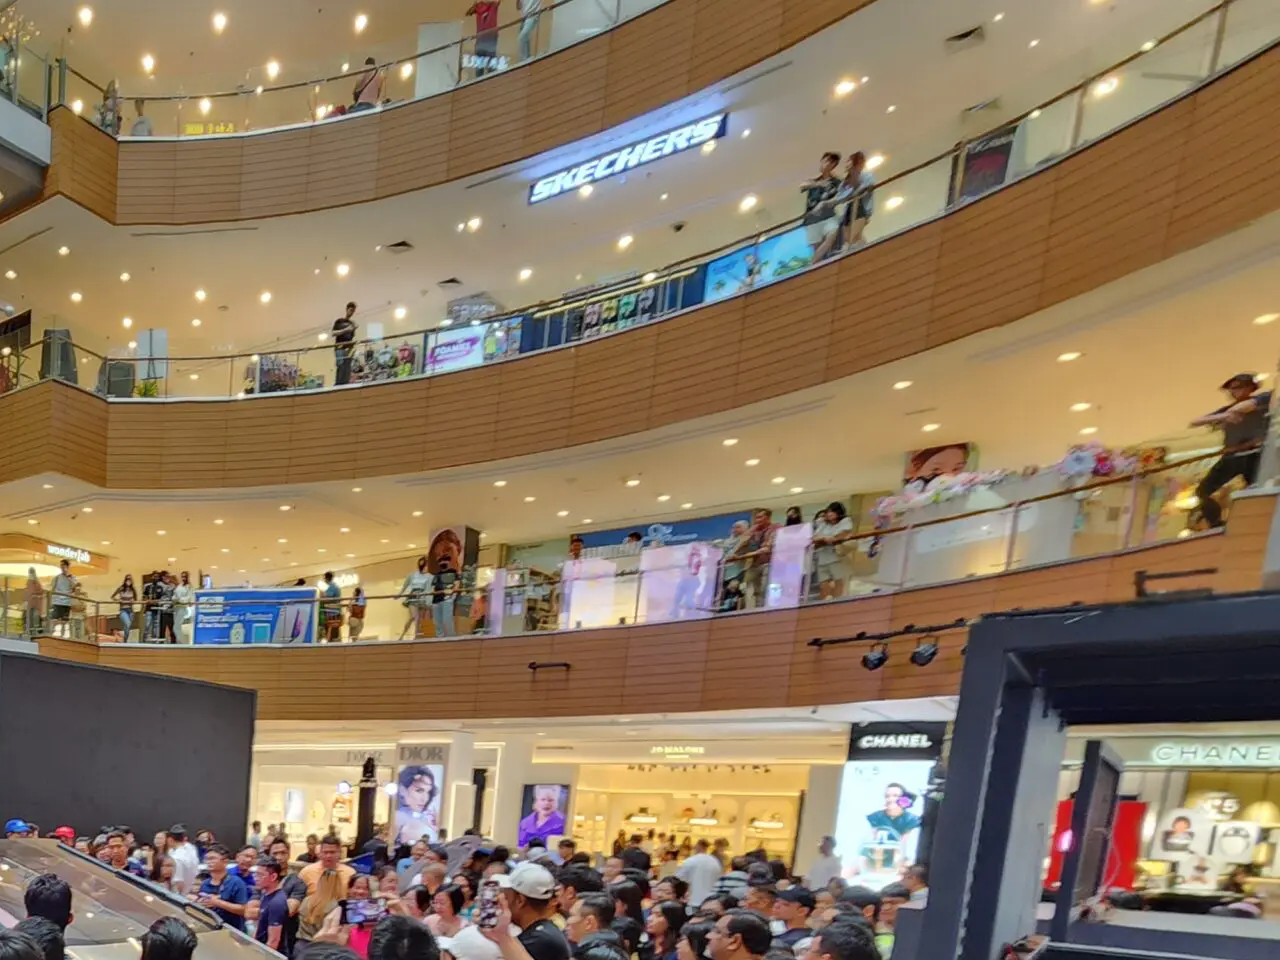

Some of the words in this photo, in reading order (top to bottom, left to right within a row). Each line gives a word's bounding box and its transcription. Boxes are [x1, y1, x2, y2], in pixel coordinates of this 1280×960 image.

[530, 115, 723, 203] SKECHERS
[858, 733, 933, 749] CHANEL
[400, 746, 444, 761] DIOR
[1156, 745, 1280, 761] CHANE
